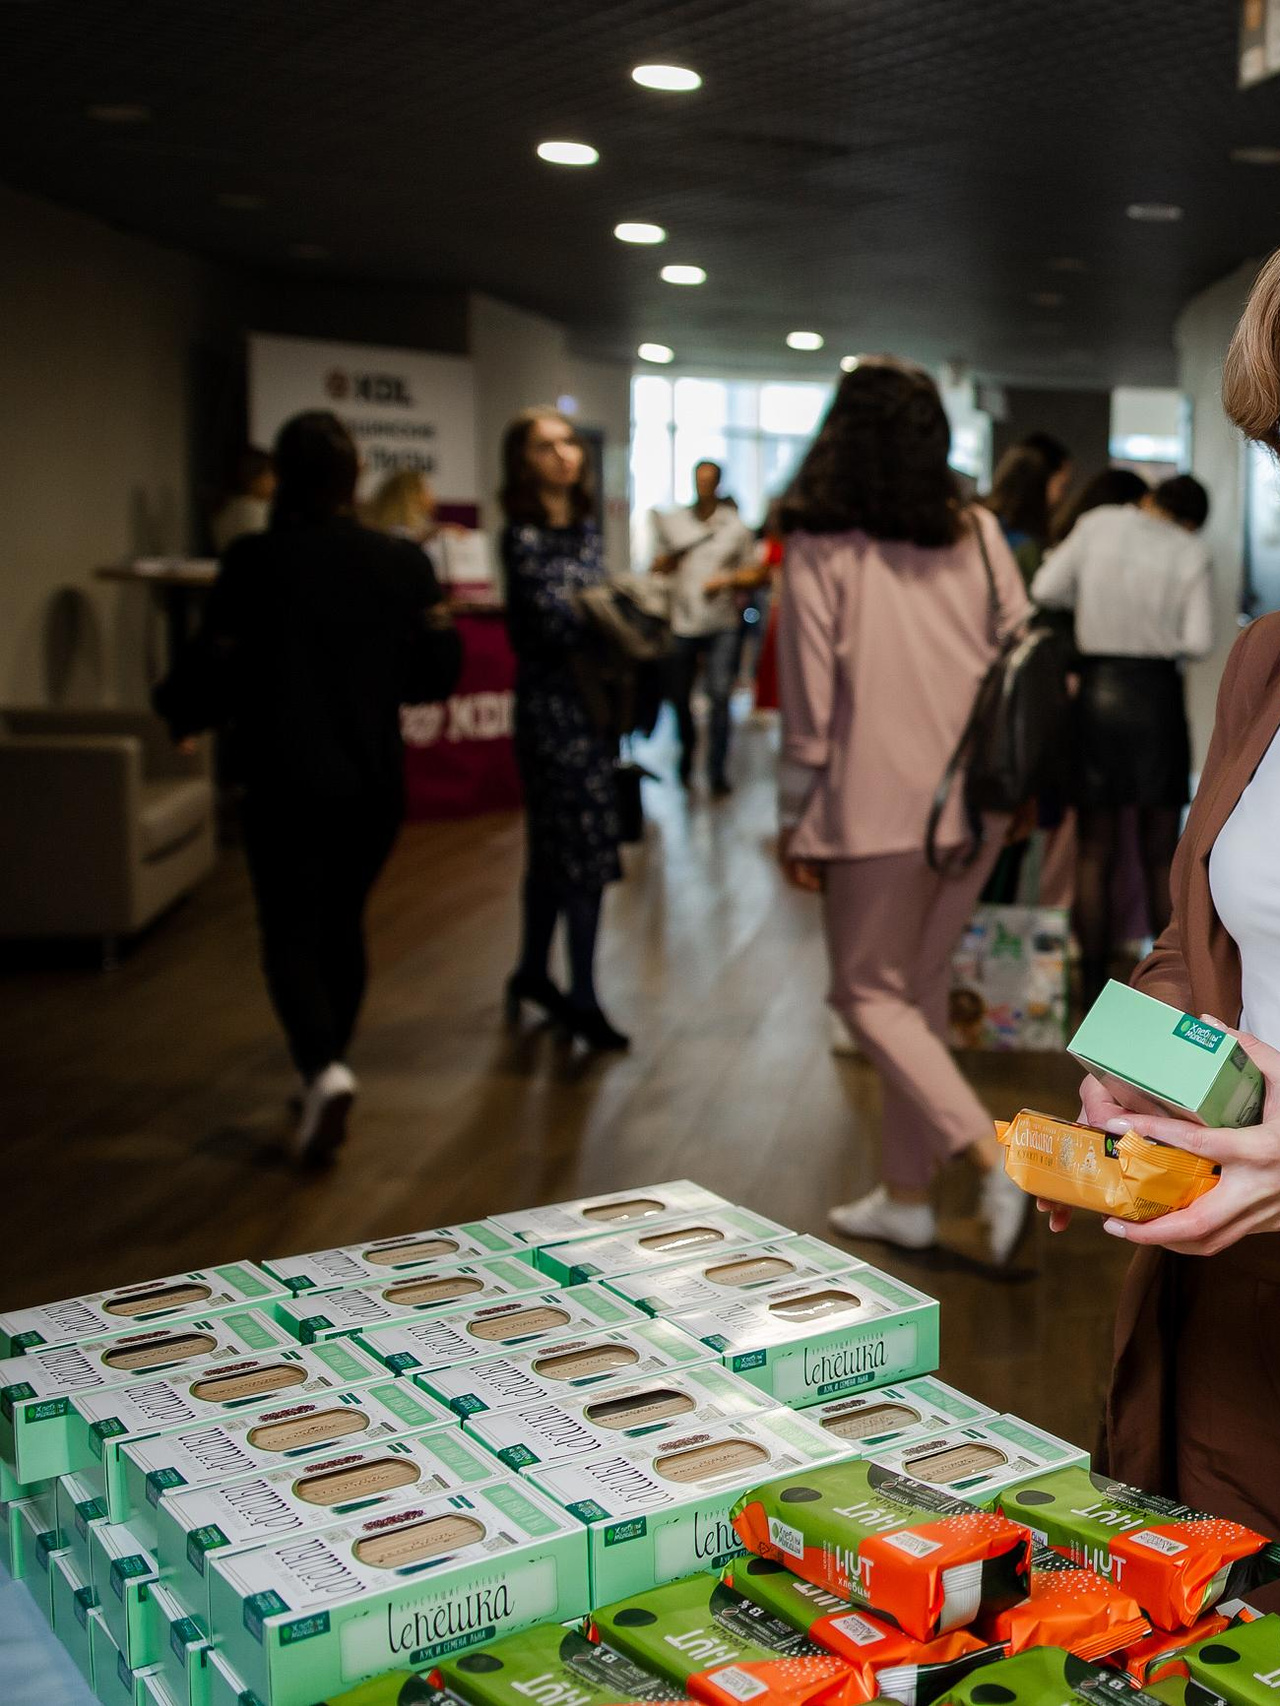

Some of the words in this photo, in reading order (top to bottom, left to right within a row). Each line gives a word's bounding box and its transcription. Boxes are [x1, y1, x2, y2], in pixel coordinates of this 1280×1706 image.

[838, 1577, 871, 1600] хлебцы
[738, 1599, 752, 1610] %
[747, 1605, 765, 1618] 13
[443, 1636, 467, 1655] СЕМЕНА
[1109, 1680, 1125, 1690] 13
